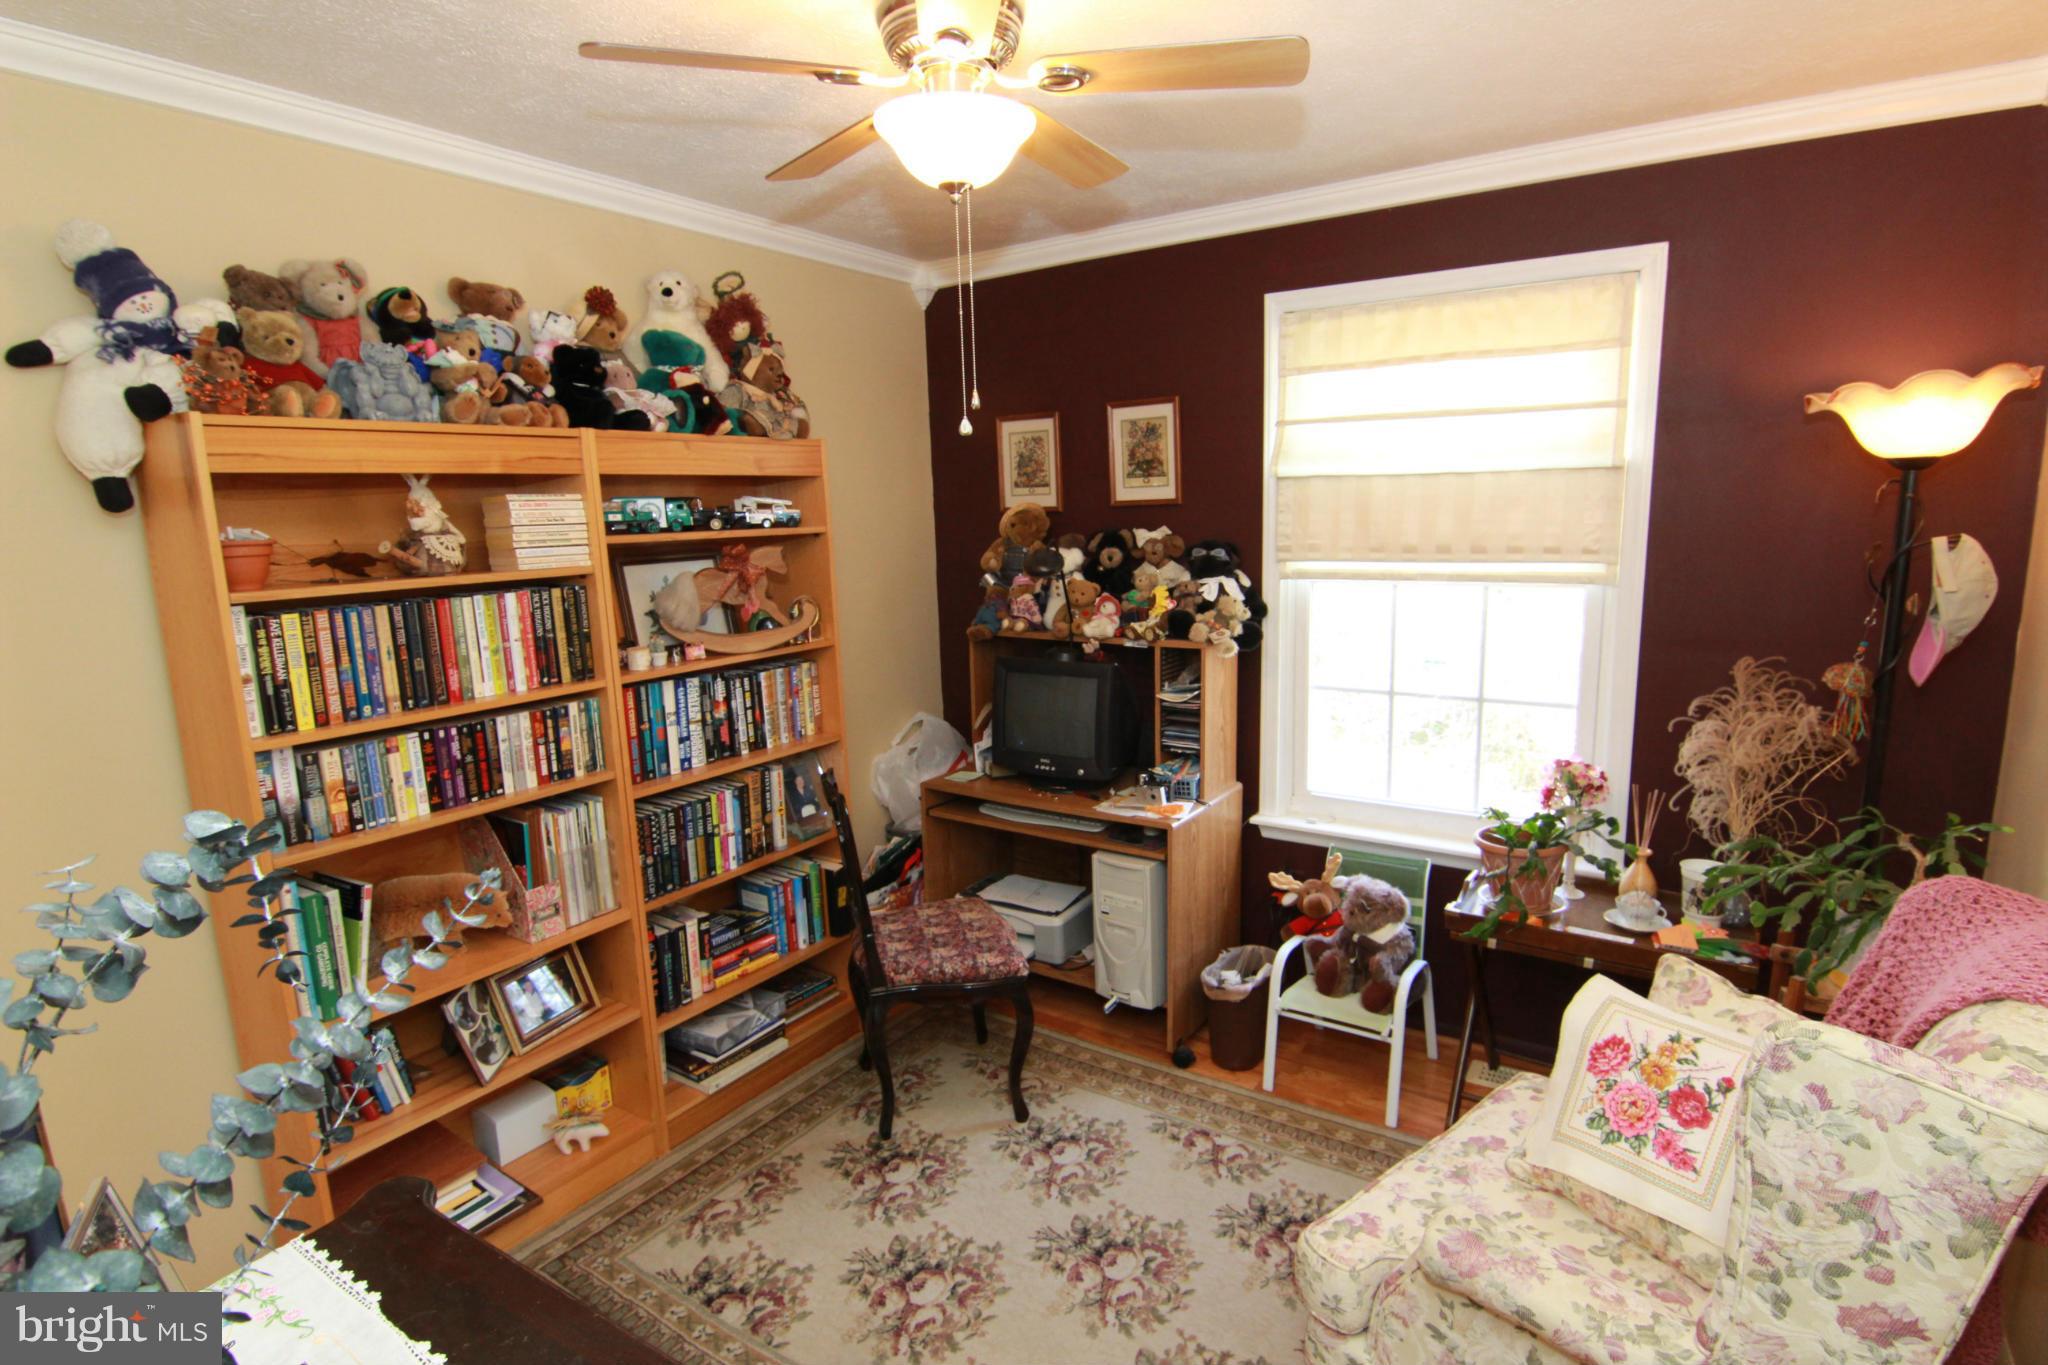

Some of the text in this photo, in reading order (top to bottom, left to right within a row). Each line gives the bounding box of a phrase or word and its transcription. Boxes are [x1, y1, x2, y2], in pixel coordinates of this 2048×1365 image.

[534, 609, 543, 636] HIGGINS
[269, 619, 287, 680] FAYE KELLERMAN
